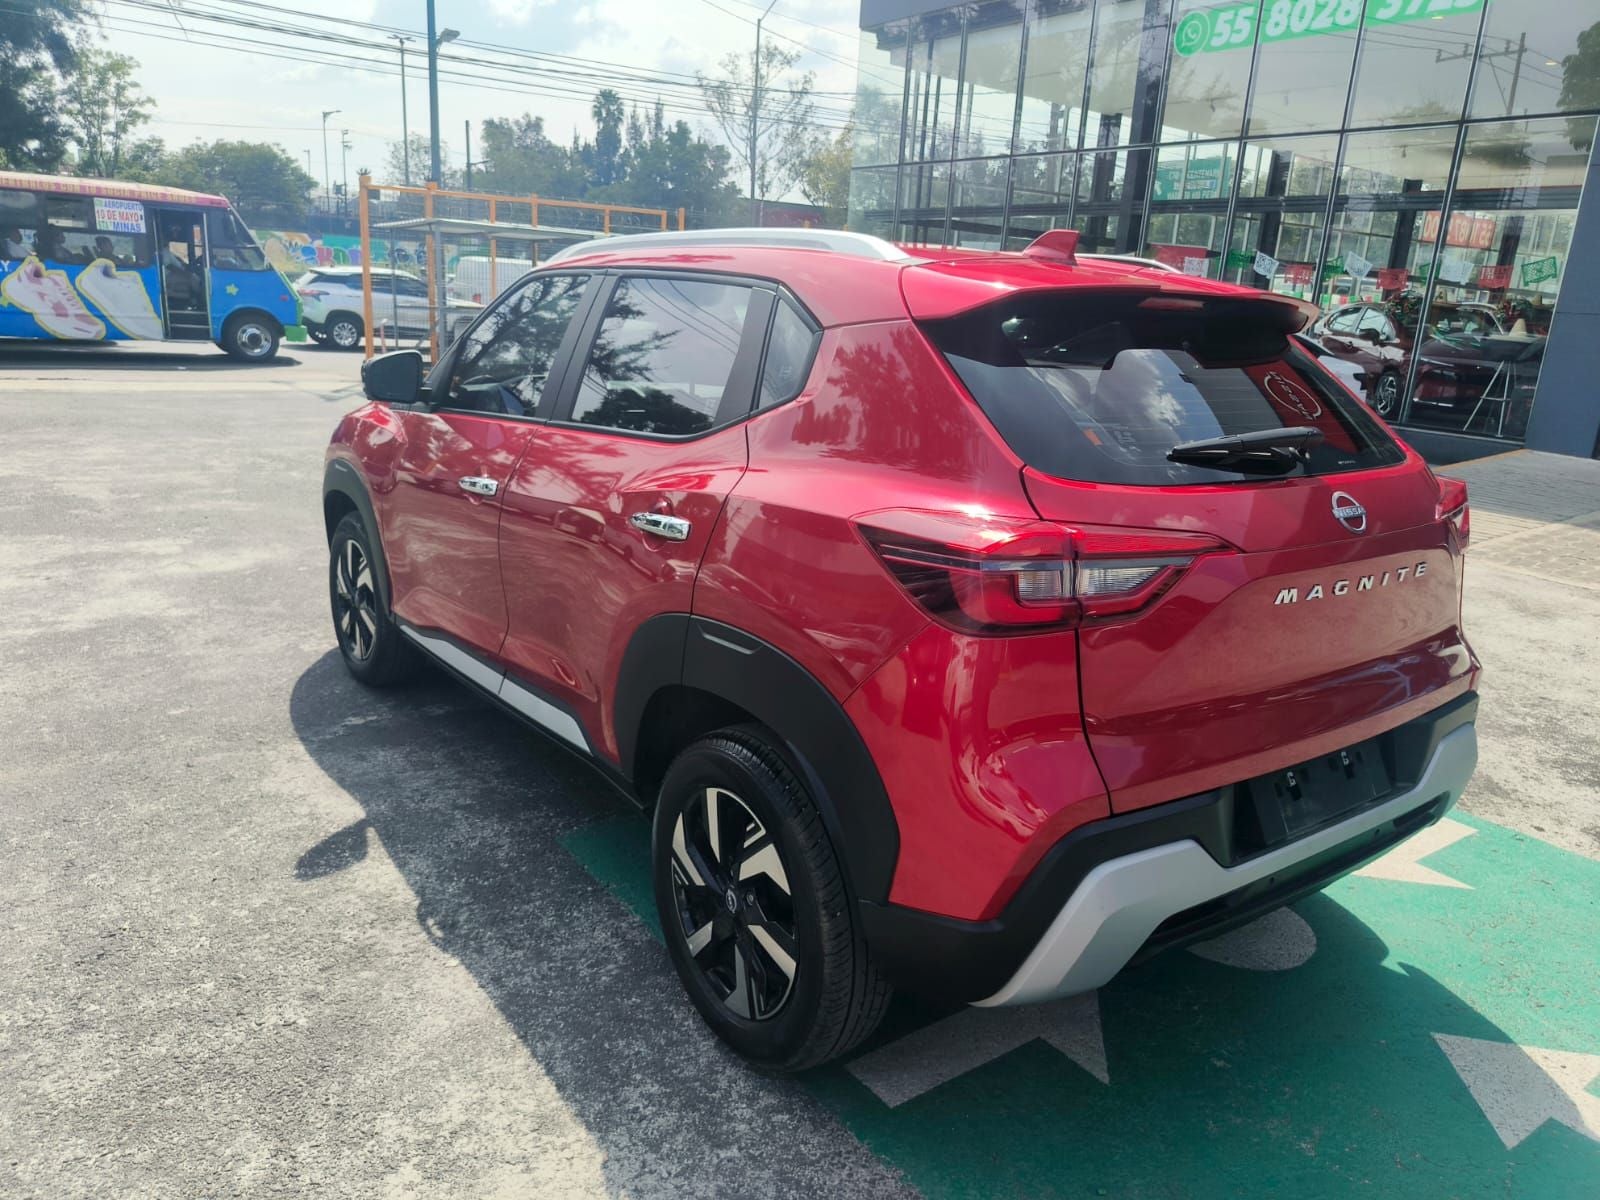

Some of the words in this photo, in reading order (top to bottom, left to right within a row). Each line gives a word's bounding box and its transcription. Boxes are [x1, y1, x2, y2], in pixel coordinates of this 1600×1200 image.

[1210, 7, 1254, 47] 55
[1265, 0, 1361, 36] 8028
[106, 209, 117, 220] DE
[118, 210, 139, 223] MAYO
[1274, 562, 1428, 604] MAGNITE
